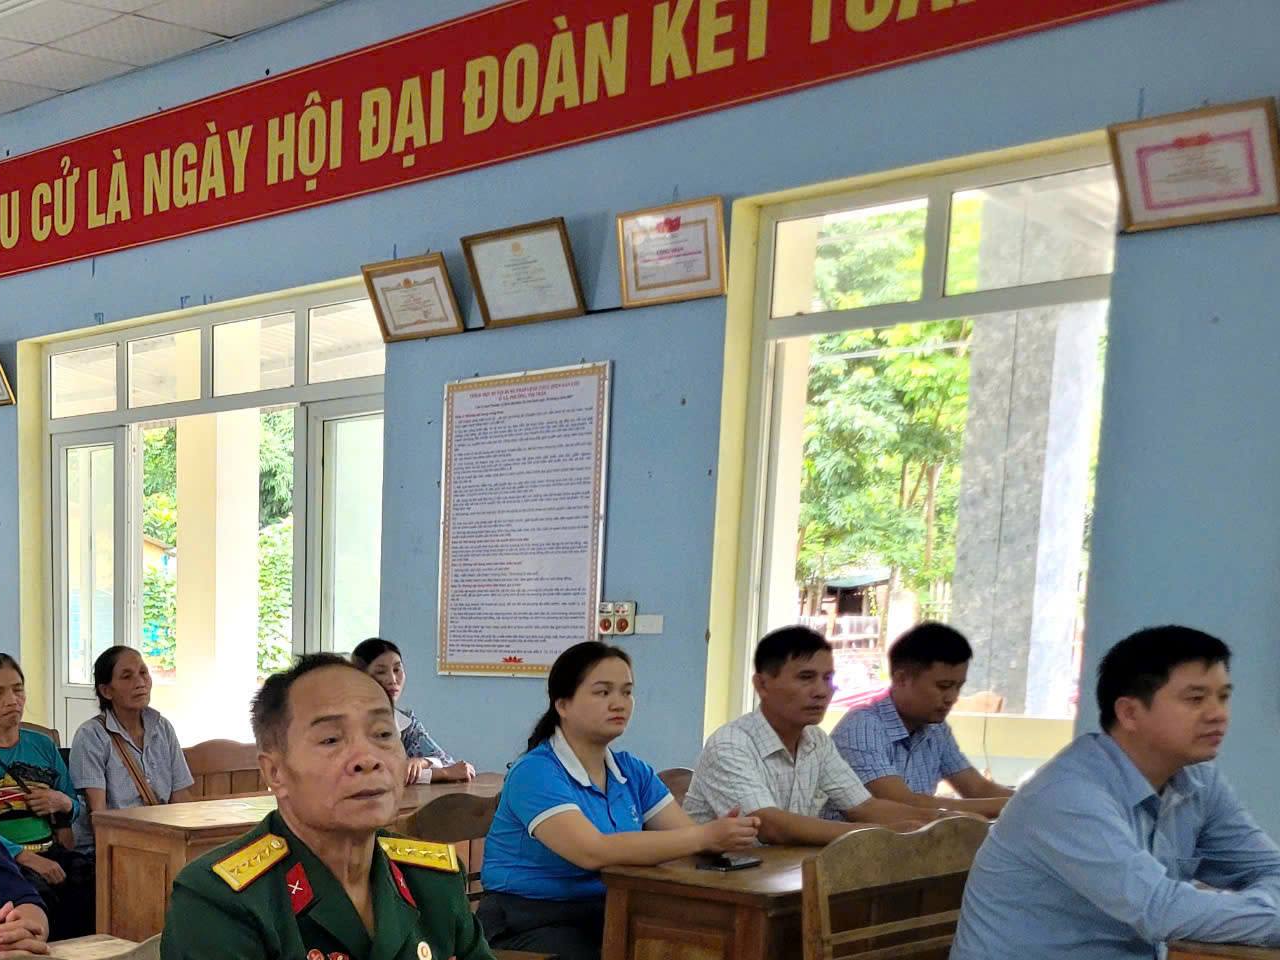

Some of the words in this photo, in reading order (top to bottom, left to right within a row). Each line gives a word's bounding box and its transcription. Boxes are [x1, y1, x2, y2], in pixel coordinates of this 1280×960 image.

[31, 155, 80, 241] CỬ
[87, 148, 131, 229] LÀ
[143, 121, 254, 216] NGÀY
[266, 91, 343, 192] HỘI
[358, 69, 445, 168] ĐẠI
[462, 13, 629, 135] ĐOÀN
